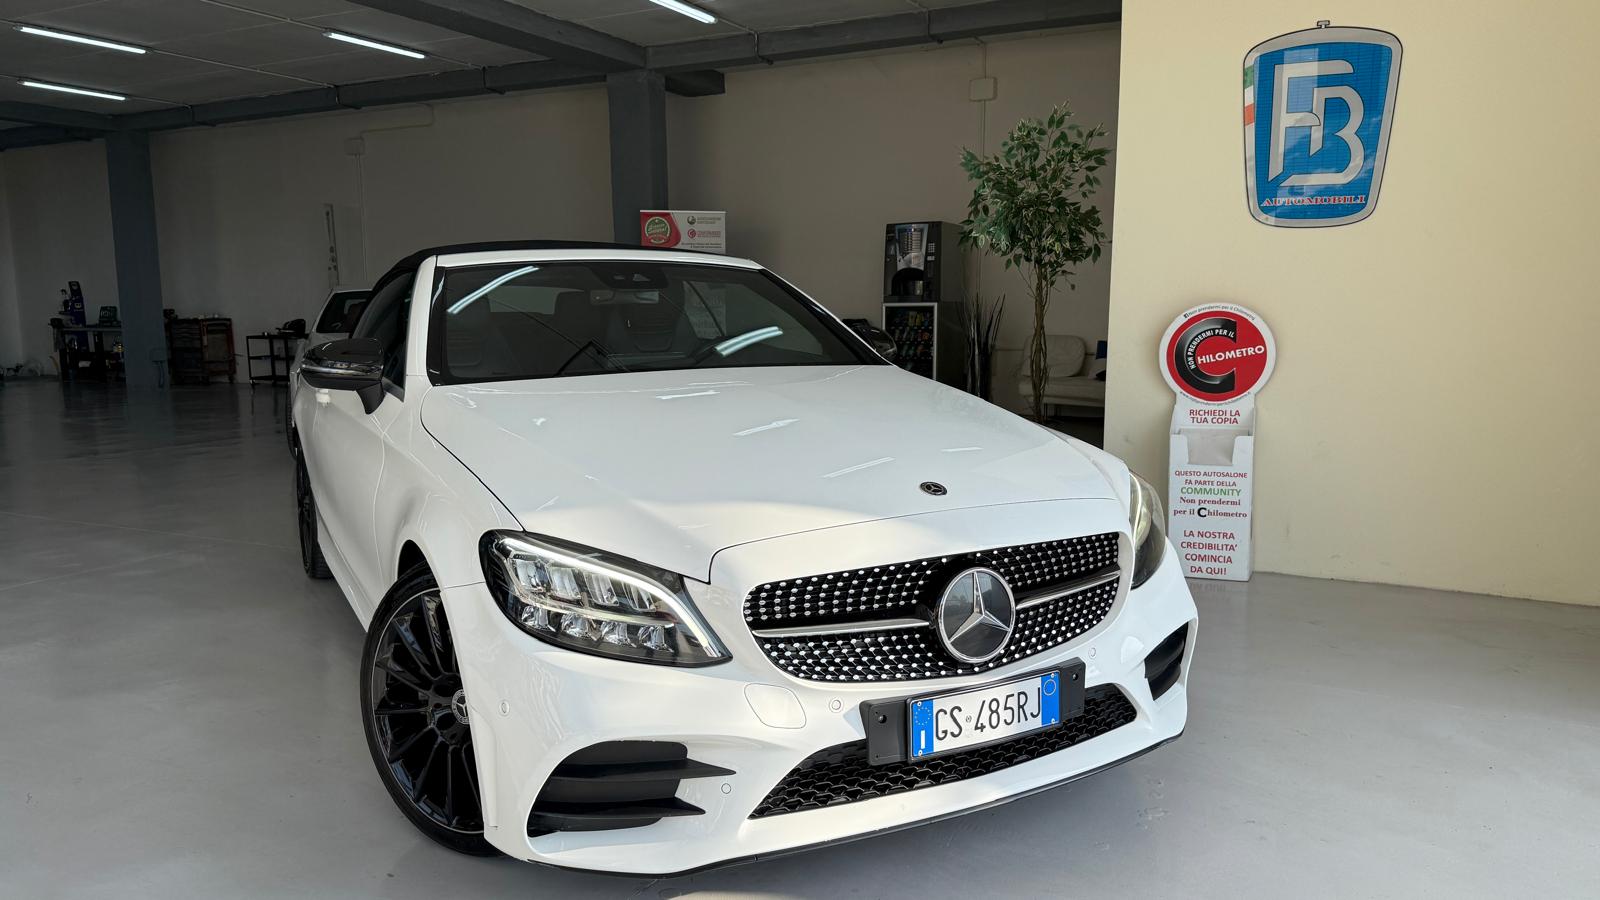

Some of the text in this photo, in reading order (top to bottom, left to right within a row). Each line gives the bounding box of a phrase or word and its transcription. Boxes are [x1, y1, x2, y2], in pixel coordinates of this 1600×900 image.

[1260, 195, 1366, 206] AUTOMOBILI
[1188, 330, 1214, 356] PRENDERMI
[1180, 487, 1241, 496] COMMUNITY
[1197, 507, 1247, 518] Chilometro
[1197, 531, 1235, 540] NOSTRA
[1185, 553, 1232, 564] COMINCIA
[1206, 567, 1227, 576] QUI!
[935, 687, 1041, 741] GS 485RJ
